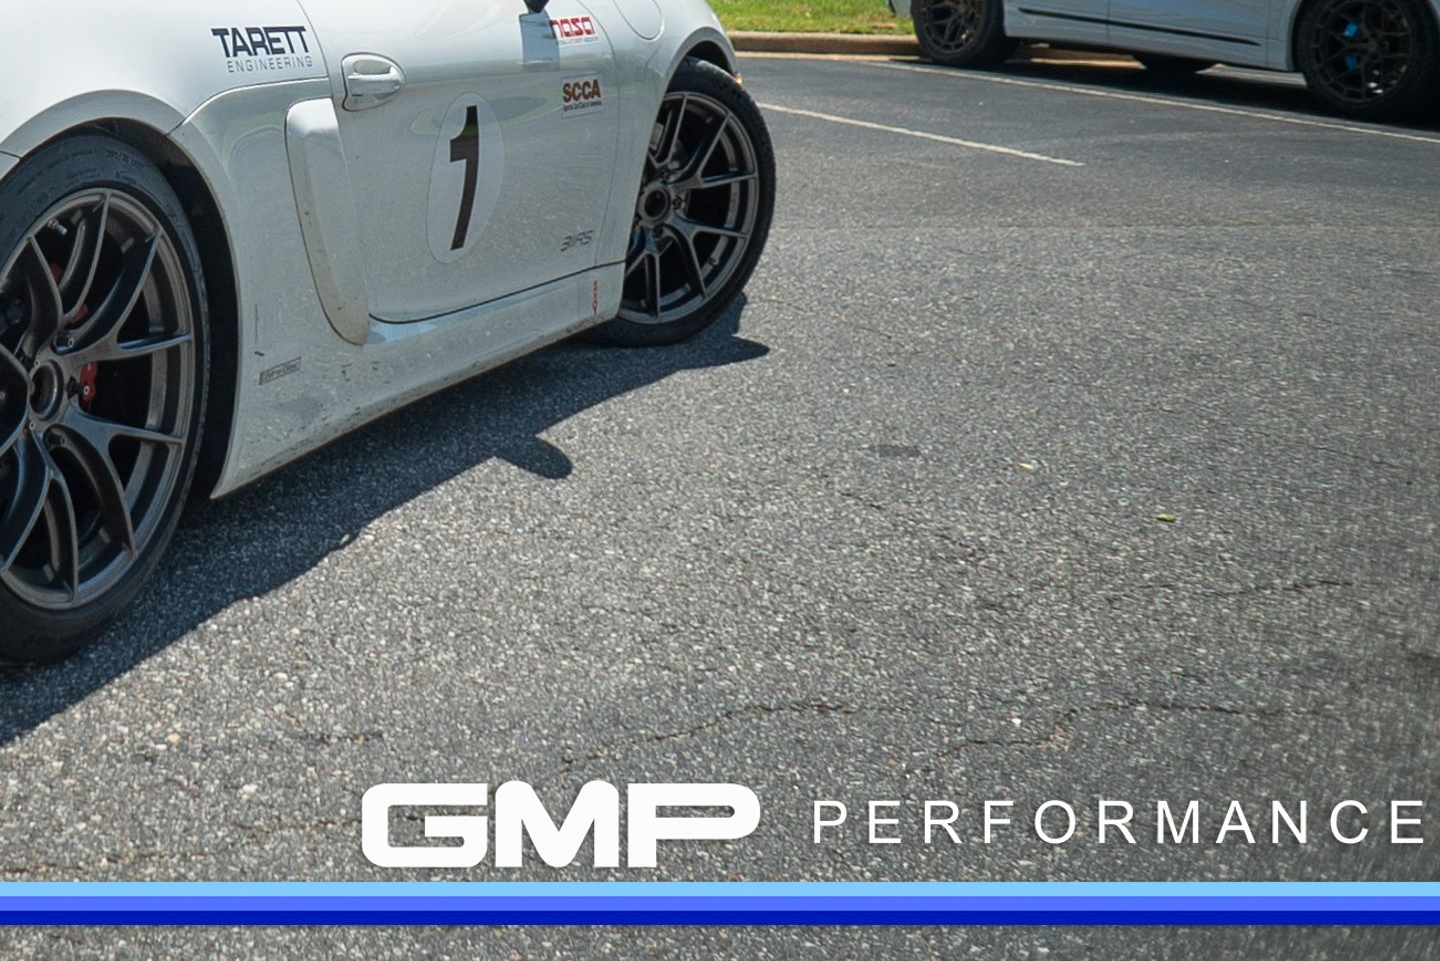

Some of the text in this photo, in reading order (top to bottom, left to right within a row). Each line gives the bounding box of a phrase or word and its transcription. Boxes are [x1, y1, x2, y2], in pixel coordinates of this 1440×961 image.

[211, 26, 310, 58] TARETT
[227, 56, 313, 73] ENGINEERING
[563, 79, 601, 102] SCCA
[449, 105, 480, 250] 1
